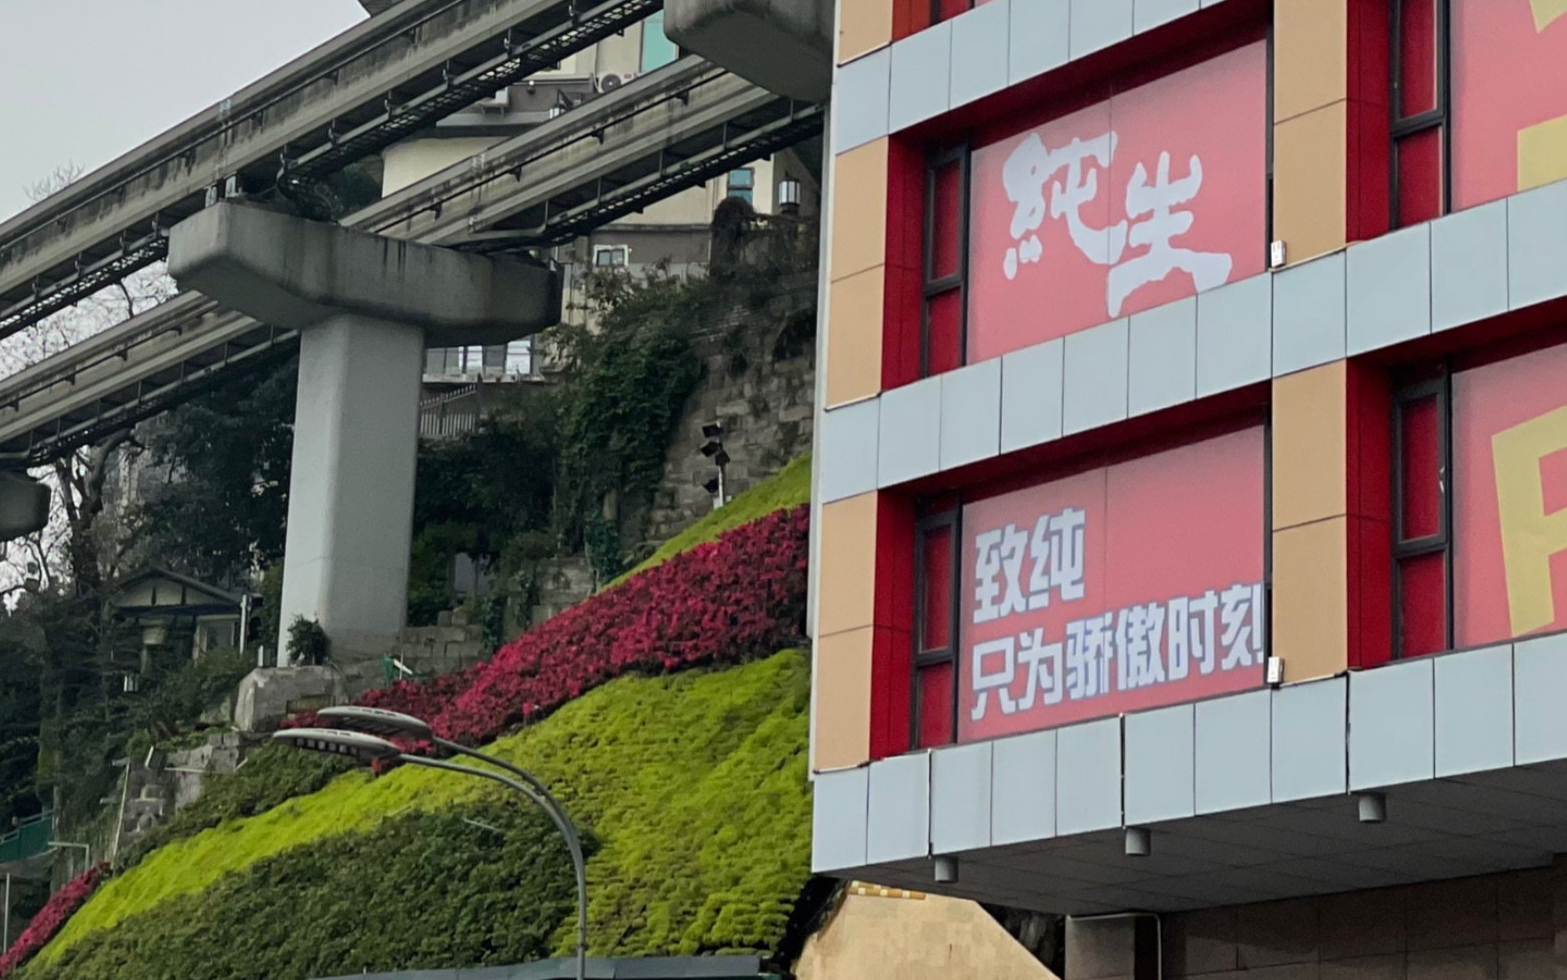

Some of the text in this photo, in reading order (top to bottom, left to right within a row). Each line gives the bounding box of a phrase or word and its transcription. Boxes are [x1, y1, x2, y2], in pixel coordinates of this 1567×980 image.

[972, 507, 1086, 624] 致纯
[970, 582, 1265, 722] 只为骄傲时刻
